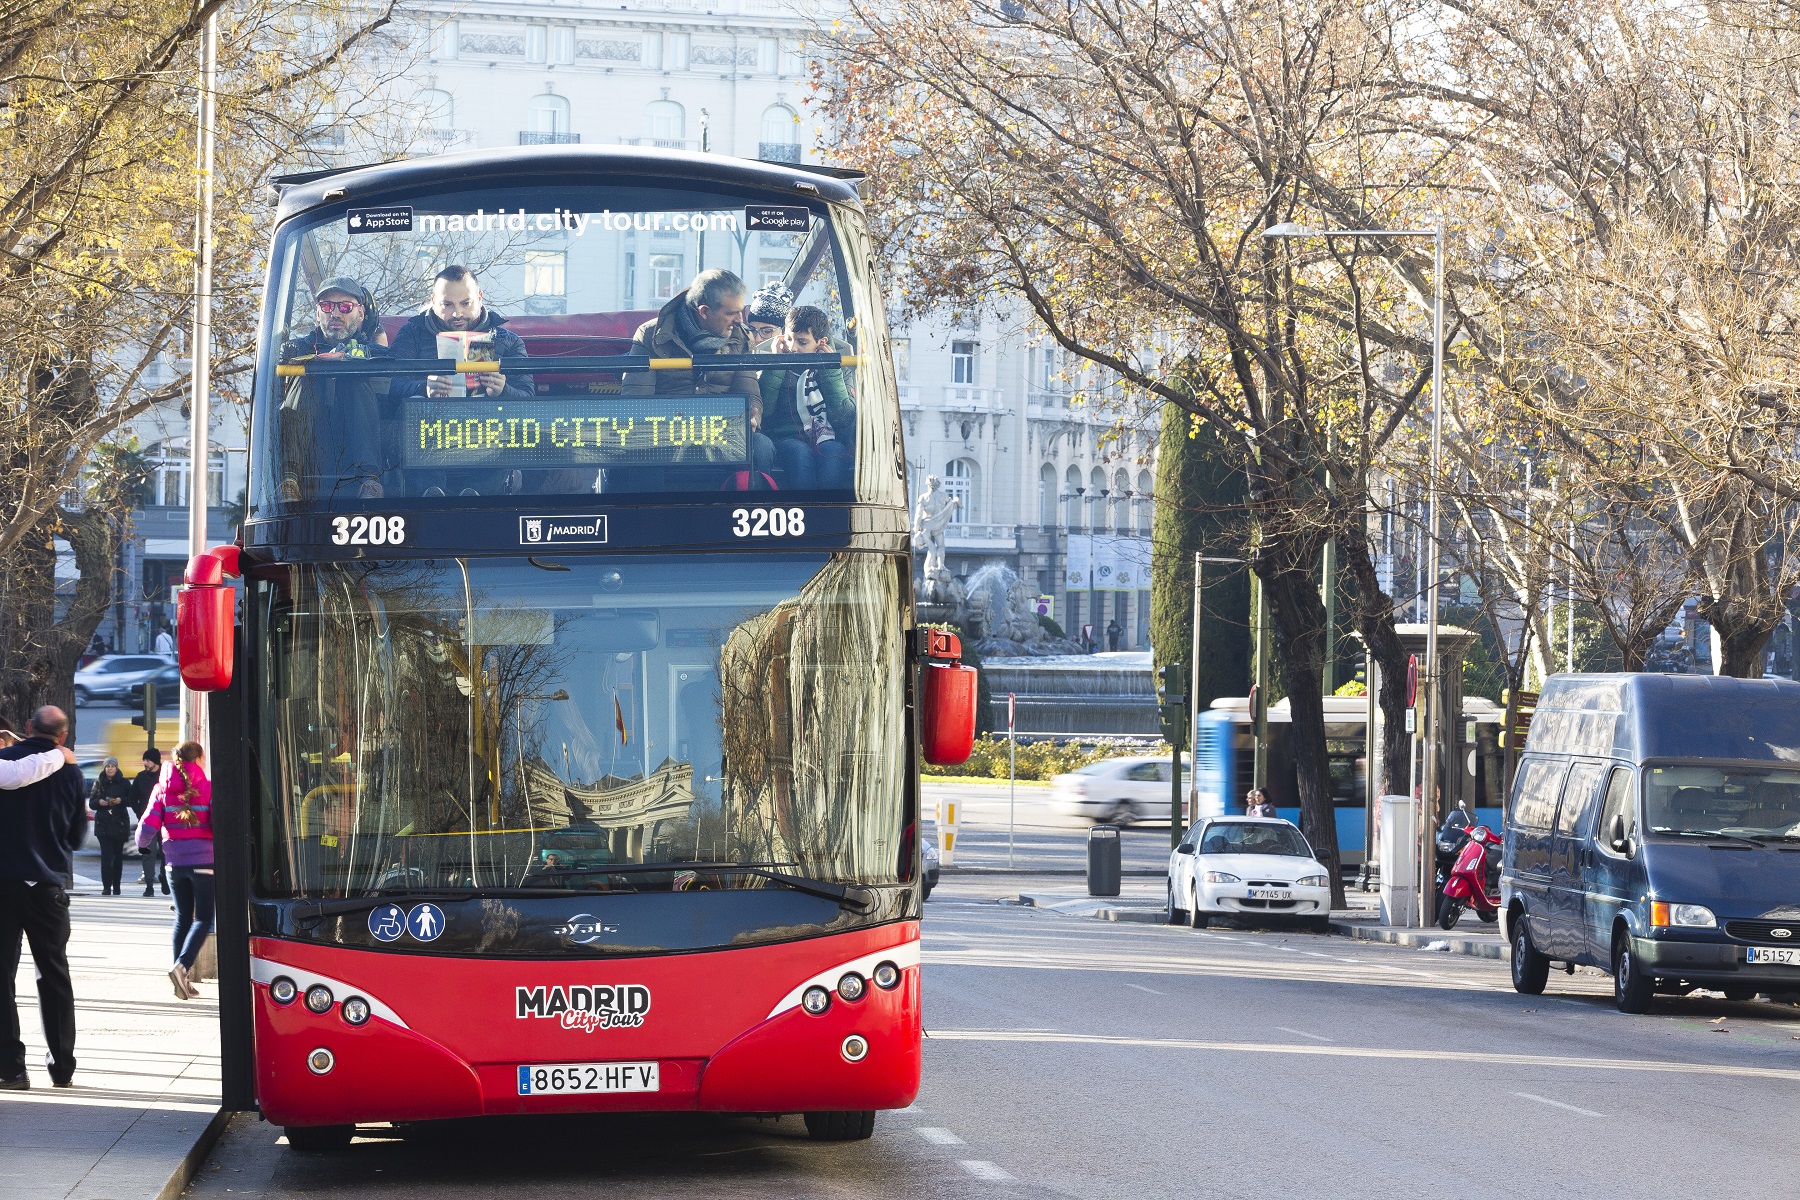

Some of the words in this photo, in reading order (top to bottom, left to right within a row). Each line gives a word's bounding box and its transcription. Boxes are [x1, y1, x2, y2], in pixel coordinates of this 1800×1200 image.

[366, 219, 385, 228] App
[386, 218, 410, 226] Store
[419, 208, 737, 237] madrid.city-tour.com
[761, 217, 789, 228] Google
[790, 218, 806, 227] play
[420, 419, 540, 449] MADRID
[551, 417, 634, 447] CITY
[644, 415, 728, 446] TOUR
[331, 516, 405, 545] 3208
[732, 507, 805, 537] 3208
[516, 984, 651, 1018] MADRID
[562, 1009, 599, 1033] City
[599, 1008, 643, 1028] Tour
[535, 1067, 598, 1090] 8652
[606, 1065, 652, 1089] HFV
